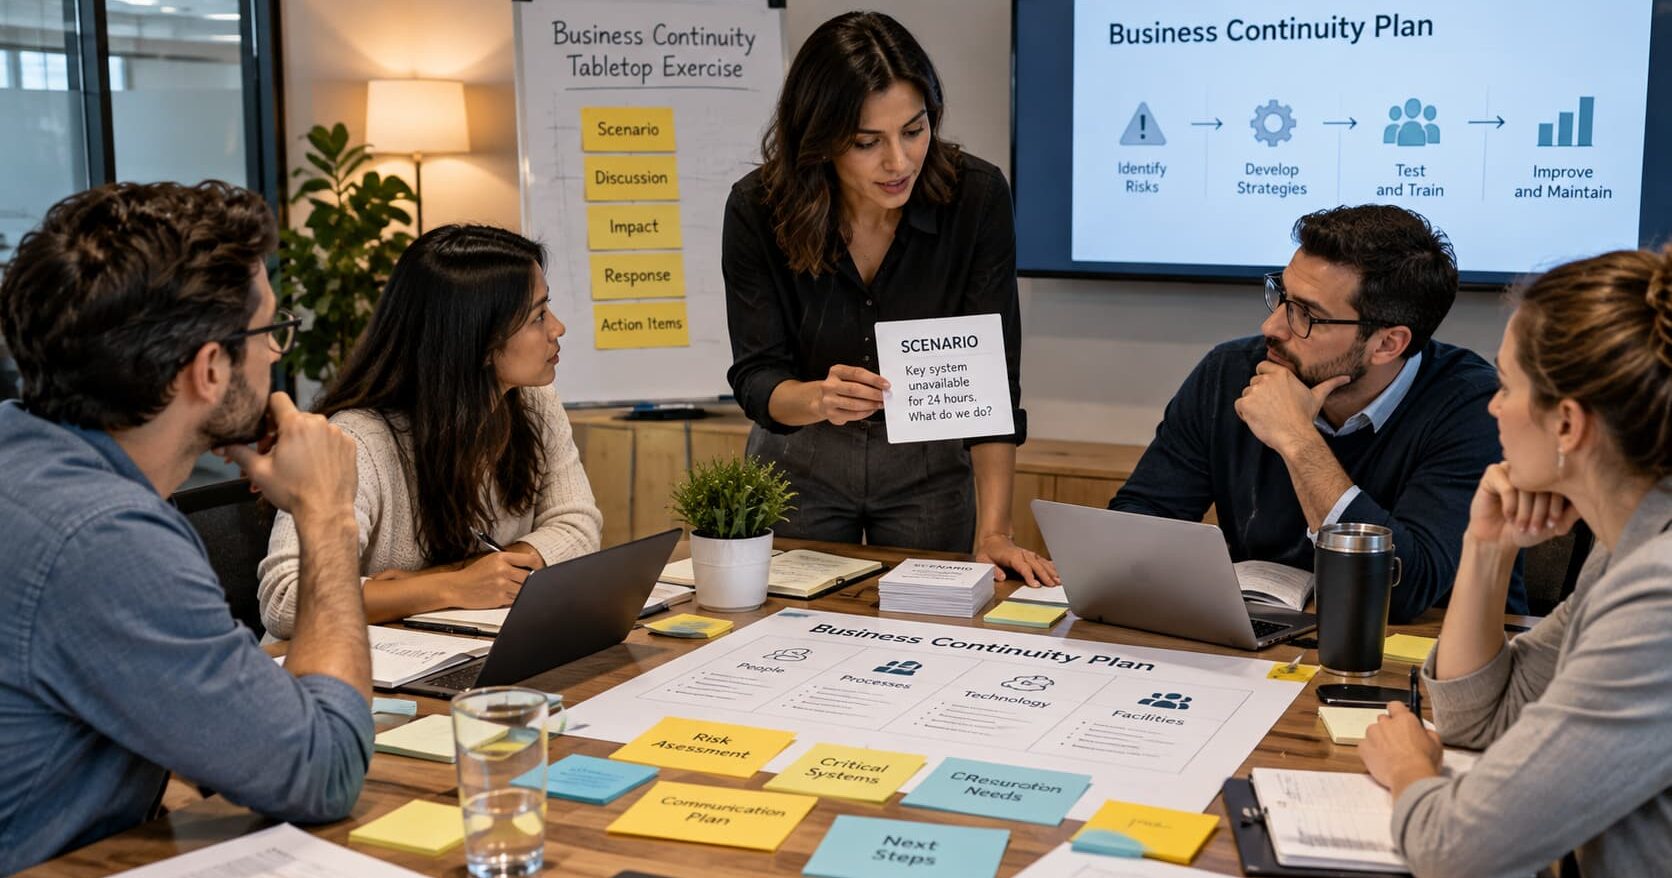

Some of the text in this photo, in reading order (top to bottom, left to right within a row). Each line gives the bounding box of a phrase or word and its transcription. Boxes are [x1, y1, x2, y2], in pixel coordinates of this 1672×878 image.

[552, 21, 756, 55] Business Continuity
[1109, 15, 1434, 45] Business Continuity Plan
[567, 54, 743, 84] Tabletop Exercise
[597, 122, 659, 136] Scenario
[595, 171, 668, 185] Discussion
[1117, 162, 1167, 178] Identify
[1245, 163, 1300, 180] Develop
[1395, 165, 1426, 178] Test
[1533, 166, 1594, 182] Improve
[1125, 180, 1159, 193] Risks
[1236, 181, 1307, 198] Strategies
[1376, 183, 1445, 197] and Train
[1513, 185, 1613, 200] and Maintain
[609, 219, 659, 236] Impact
[604, 268, 671, 286] Response
[601, 317, 683, 332] Action Items
[901, 335, 978, 353] SCENARIO
[905, 362, 967, 377] Key system
[908, 377, 970, 391] unavailable
[908, 393, 977, 407] for 24 hours.
[908, 406, 993, 422] What do we do?
[809, 624, 1156, 672] Business Continuity Plan
[737, 662, 785, 674] People
[840, 674, 912, 690] Processes
[964, 690, 1051, 709] Technology
[1112, 710, 1185, 726] Facilities
[692, 732, 733, 745] Risk
[820, 757, 889, 773] Critical
[805, 767, 880, 784] Systems
[964, 786, 1023, 802] Needs
[685, 812, 730, 826] Plan
[882, 835, 939, 850] Next
[872, 849, 937, 866] Steps
